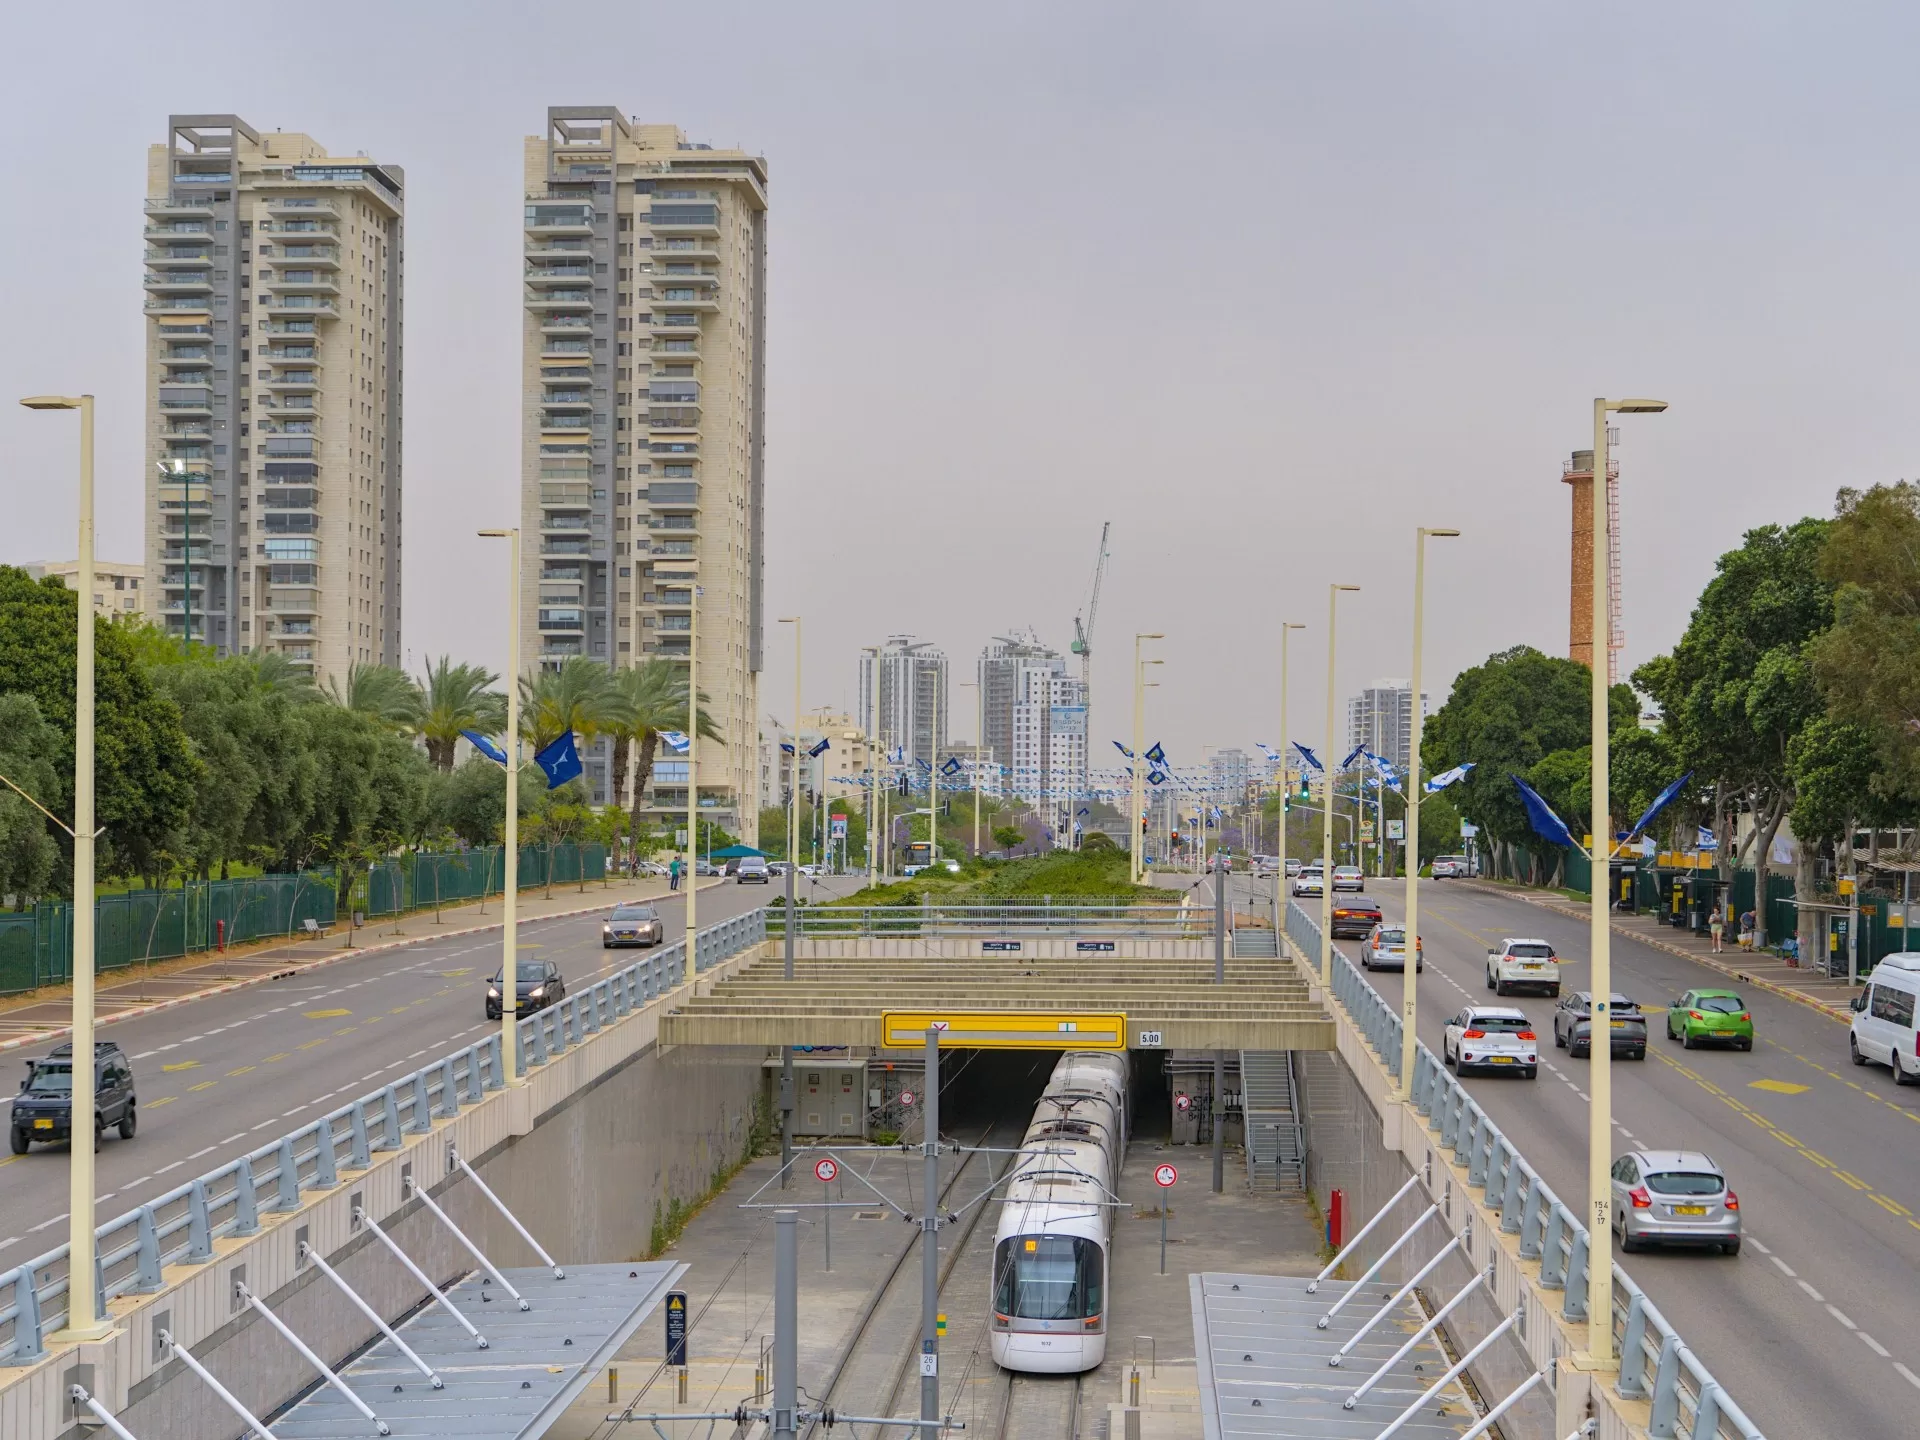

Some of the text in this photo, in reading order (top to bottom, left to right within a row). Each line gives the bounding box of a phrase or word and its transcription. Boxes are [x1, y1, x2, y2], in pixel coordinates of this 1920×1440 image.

[1142, 1034, 1159, 1043] 5.00
[1594, 1201, 1608, 1209] 154
[1597, 1217, 1606, 1225] 17
[924, 1355, 933, 1364] 26
[926, 1364, 931, 1372] 0
